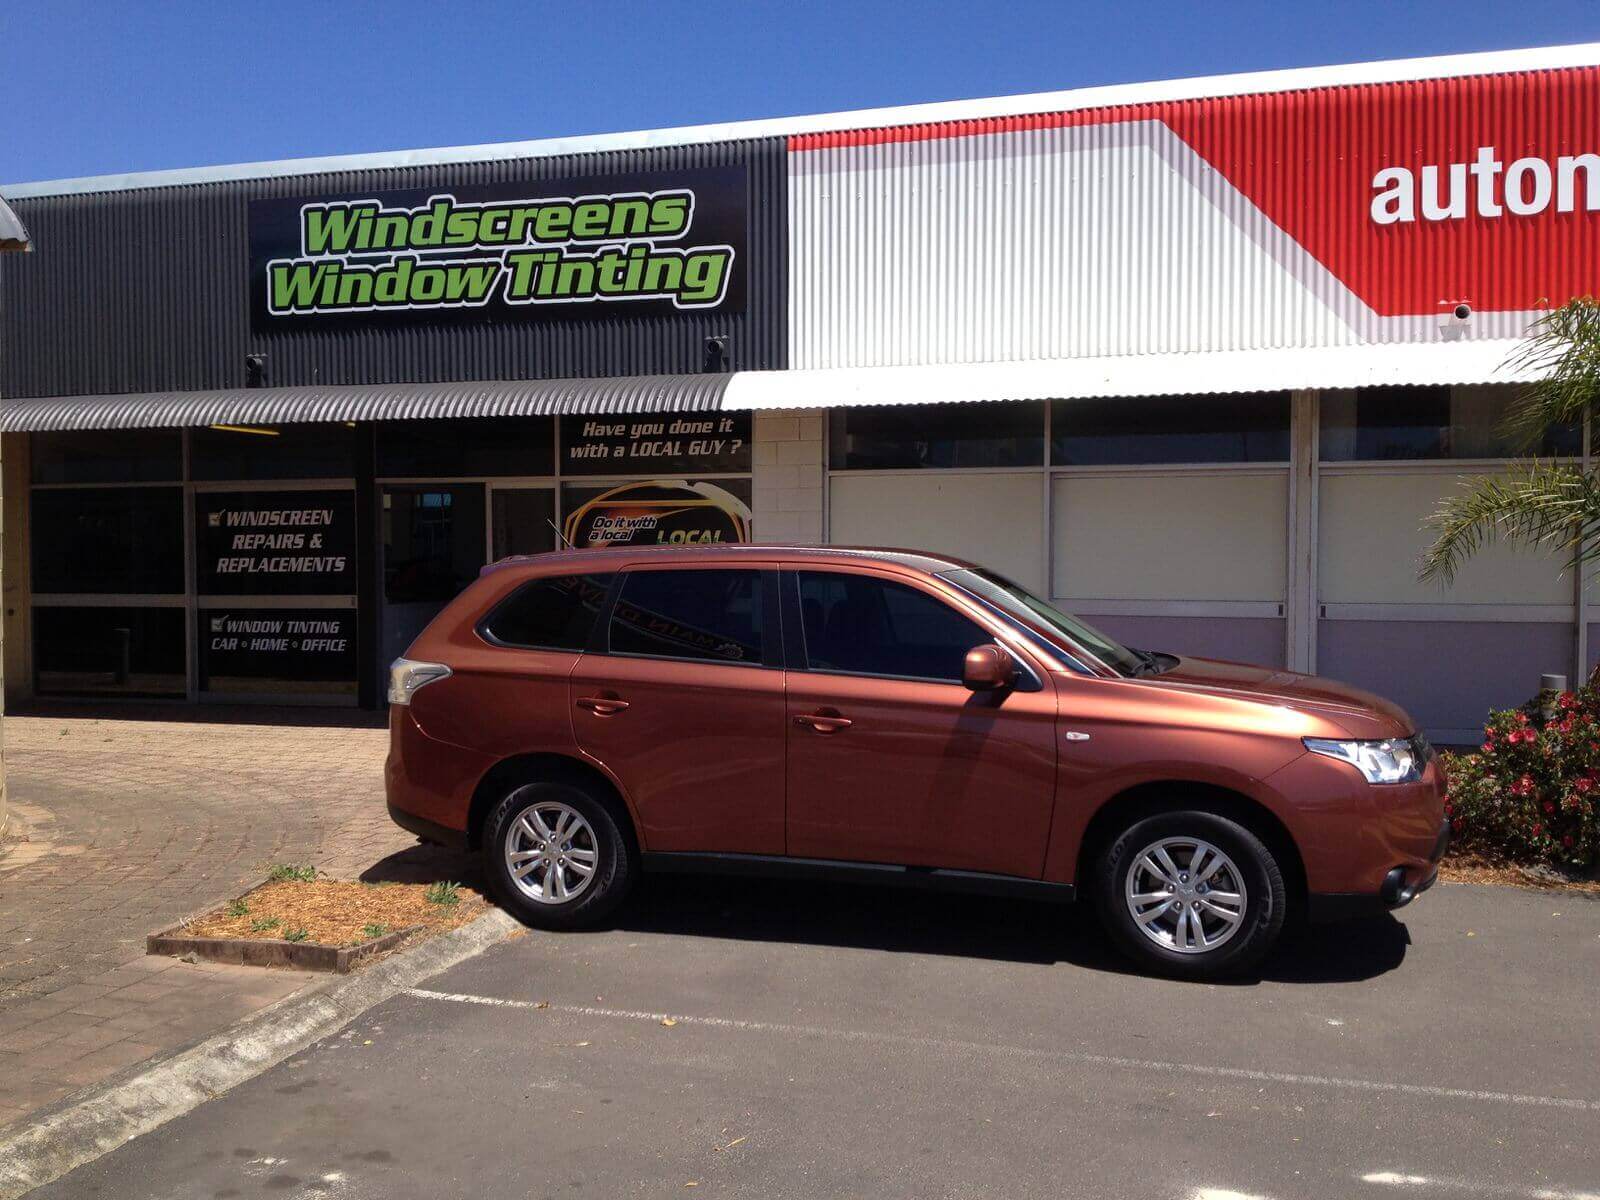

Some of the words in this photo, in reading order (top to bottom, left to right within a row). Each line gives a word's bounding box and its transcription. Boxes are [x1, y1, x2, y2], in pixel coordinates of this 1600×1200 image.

[304, 193, 692, 254] Windscreens
[269, 256, 500, 310] Window
[505, 244, 731, 303] Tinting
[582, 421, 626, 437] Have
[630, 422, 664, 439] you
[669, 419, 713, 434] done
[718, 417, 734, 433] it
[570, 443, 608, 459] with
[613, 446, 624, 458] a
[630, 440, 683, 457] LOCAL
[689, 439, 726, 456] GUY
[730, 438, 742, 455] ?
[226, 509, 334, 527] WINDSCREEN
[593, 517, 614, 529] Do
[615, 516, 627, 529] it
[627, 515, 657, 529] with
[232, 533, 305, 550] REPAIRS
[309, 533, 323, 549] &
[589, 530, 601, 541] a
[602, 528, 635, 541] local
[656, 529, 727, 545] LOCAL
[216, 556, 346, 573] REPLACEMENTS
[226, 620, 284, 633] WINDOW
[287, 621, 340, 634] TINTING
[211, 638, 238, 650] CAR
[250, 638, 289, 651] HOME
[301, 638, 347, 652] OFFICE
